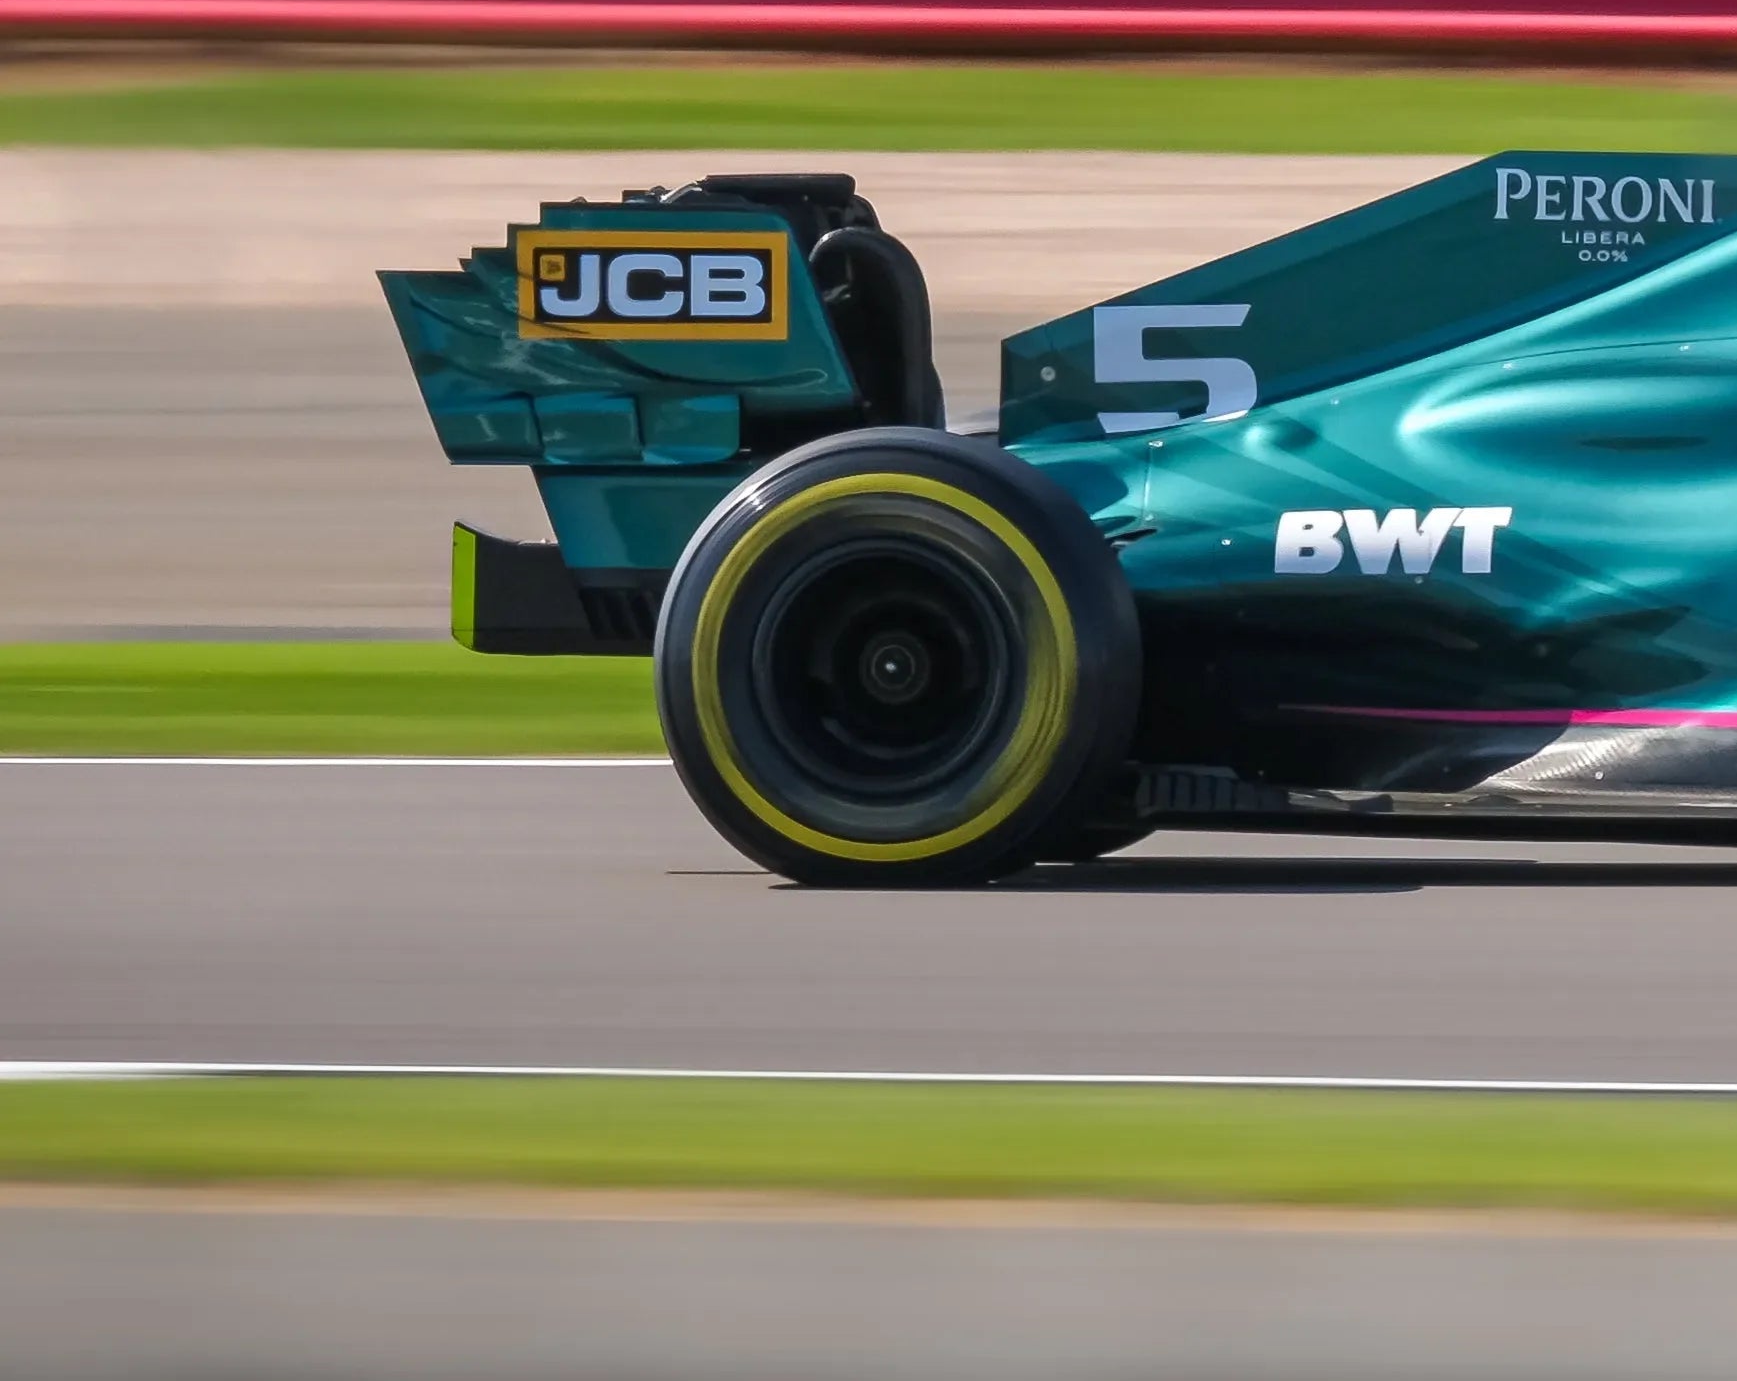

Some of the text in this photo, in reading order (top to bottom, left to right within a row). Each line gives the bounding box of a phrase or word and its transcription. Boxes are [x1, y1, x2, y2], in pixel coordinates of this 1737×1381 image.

[1493, 167, 1716, 224] PERONI
[1560, 229, 1646, 246] LIBERA
[1577, 249, 1629, 263] 0.0%
[539, 253, 766, 317] JCB
[1093, 303, 1259, 434] 5
[1273, 505, 1513, 575] BWT
